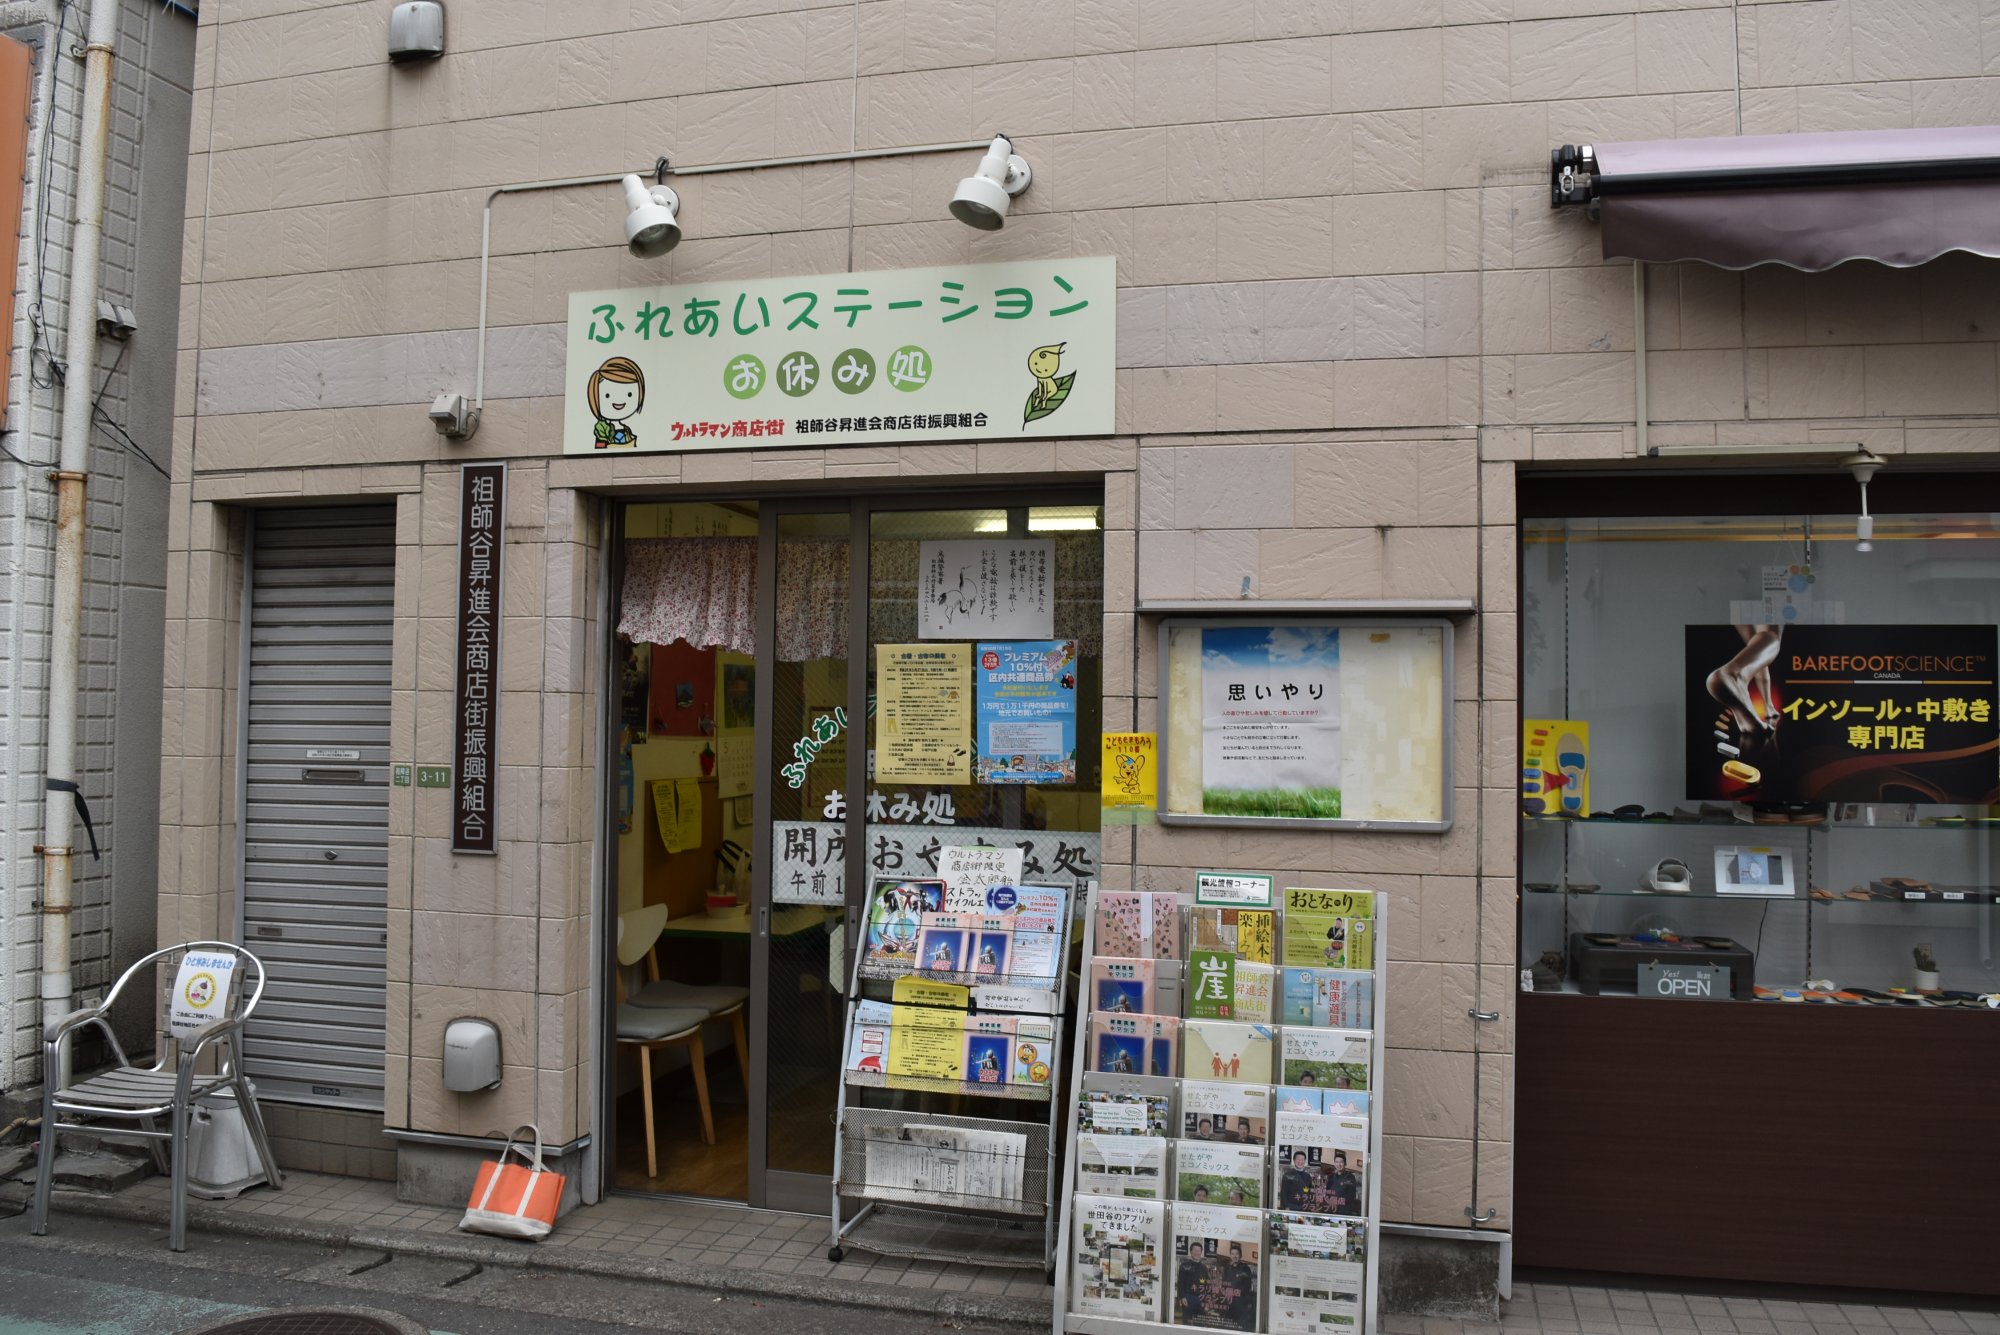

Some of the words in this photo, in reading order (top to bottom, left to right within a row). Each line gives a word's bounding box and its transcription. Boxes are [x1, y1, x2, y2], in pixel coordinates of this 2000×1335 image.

[588, 275, 1089, 343] ふれあいステーション
[730, 350, 927, 393] お休み処
[795, 412, 988, 434] 祖師谷昇進会商店街振興組合
[671, 420, 785, 441] ウルトラマン商店街
[461, 476, 495, 842] 祖師谷昇進会商店街振興組合
[1228, 683, 1325, 701] 思いやり
[1782, 698, 1992, 723] インソール・中敷き
[1847, 726, 1926, 750] 専門店
[421, 770, 446, 783] 3-11
[872, 835, 1095, 878] おやみ処
[948, 850, 1005, 860] ウルトラマン
[1201, 878, 1266, 889] 観光情報コーナー
[946, 887, 987, 899] ストラッ
[1195, 955, 1228, 1001] 崖
[1236, 971, 1269, 984] 祖師谷
[1235, 984, 1269, 997] 昇進会
[1657, 978, 1711, 996] OPEN
[1286, 1047, 1336, 1057] エコノミックス
[1186, 1100, 1237, 1111] エコノミックス
[1280, 1132, 1333, 1143] エコノミックス
[1179, 1161, 1231, 1171] エコノミックス
[1087, 1210, 1154, 1225] 世田谷のアプリが
[1101, 1220, 1142, 1233] できました。
[1177, 1223, 1228, 1235] エコノミックス
